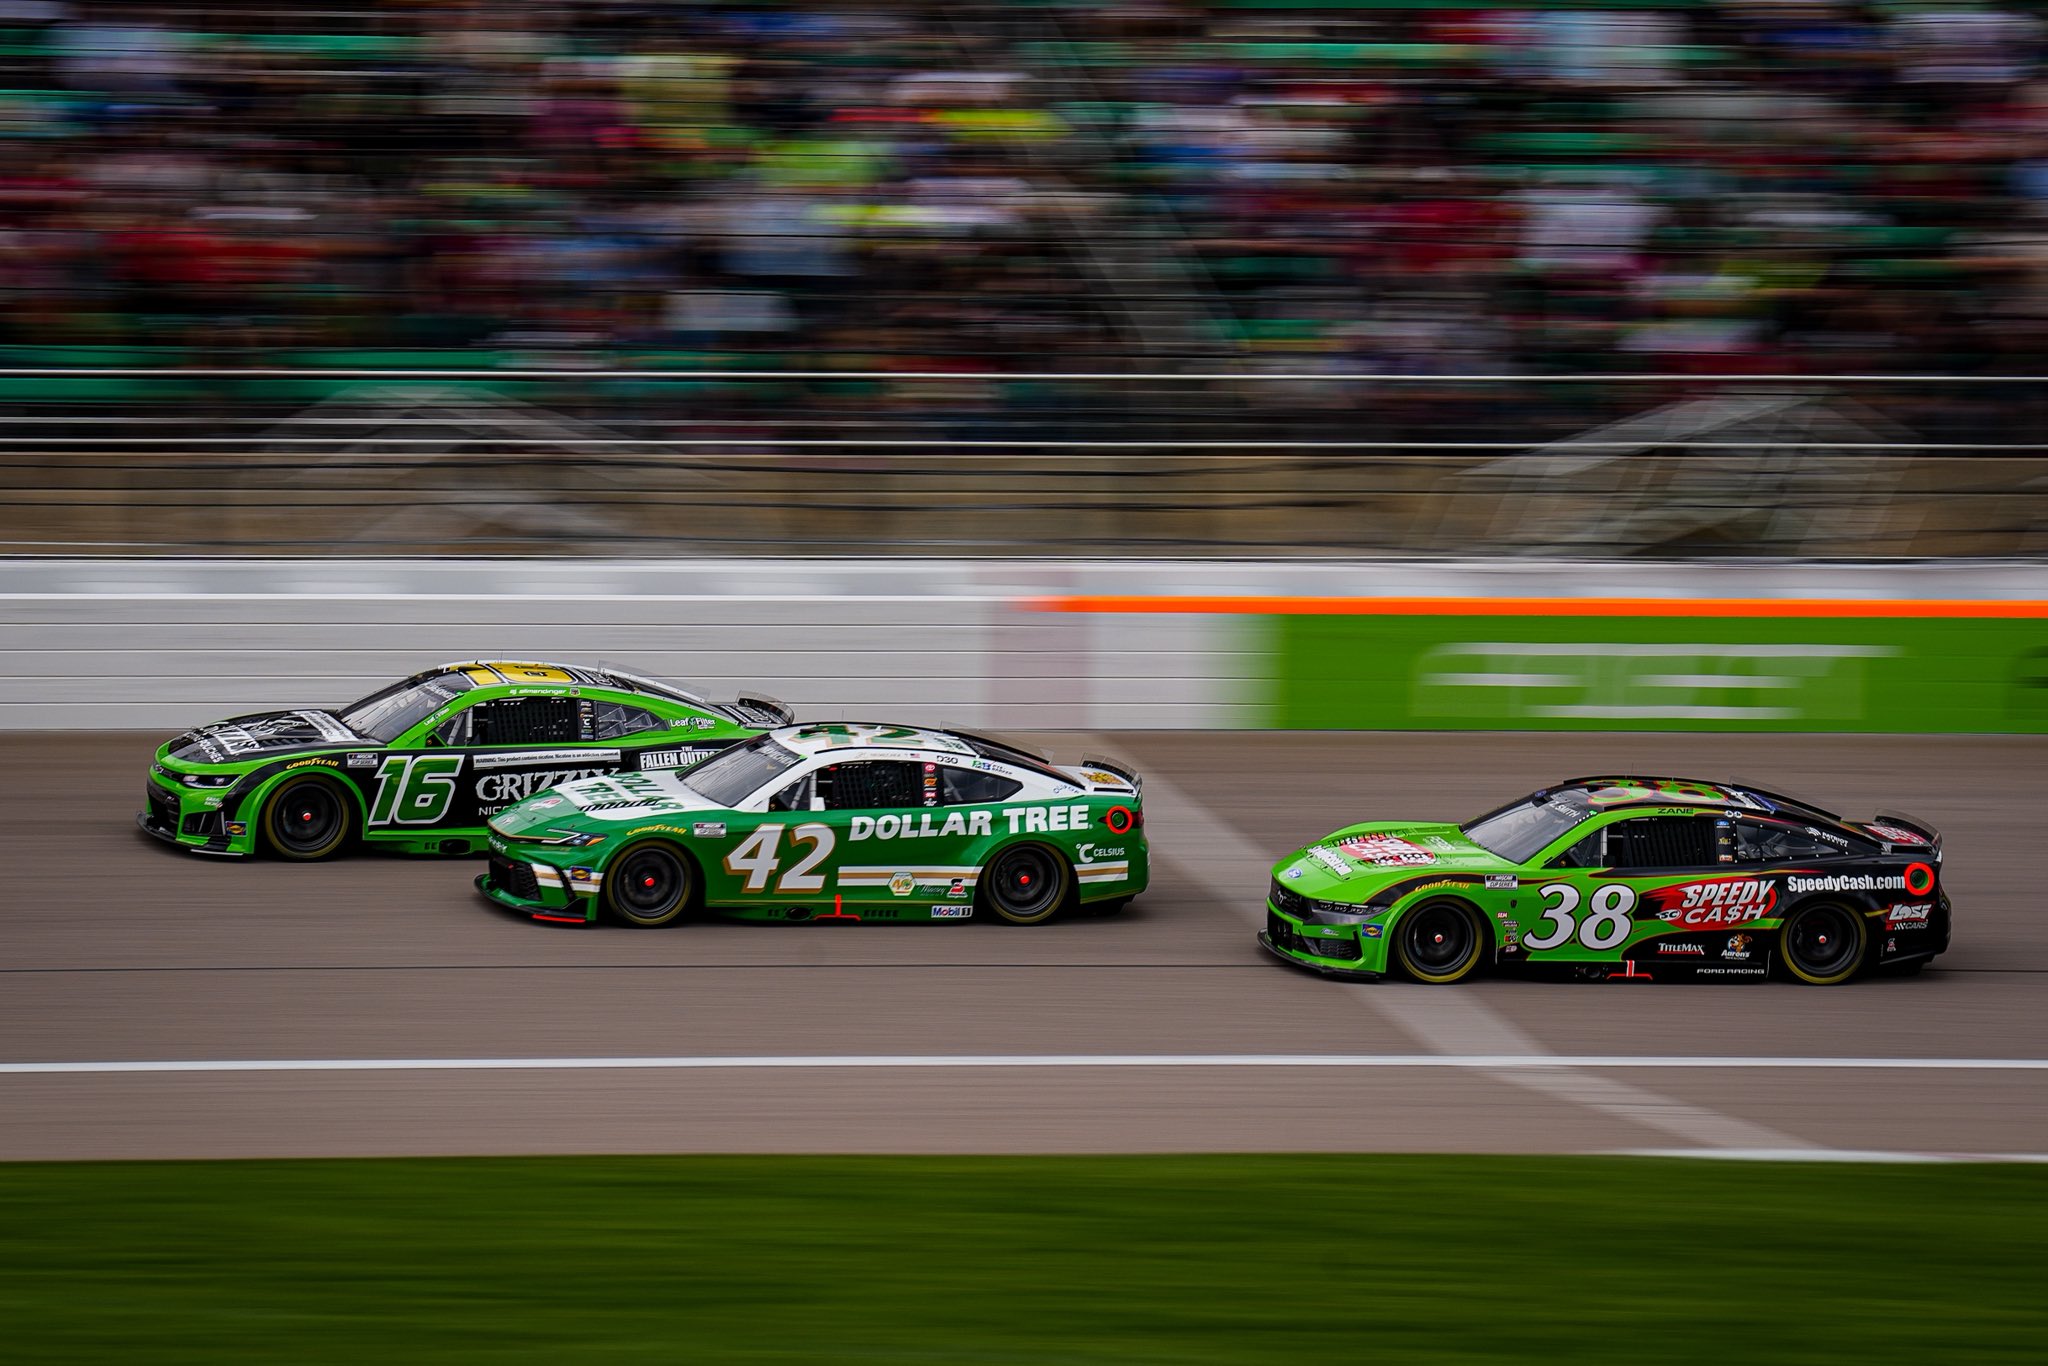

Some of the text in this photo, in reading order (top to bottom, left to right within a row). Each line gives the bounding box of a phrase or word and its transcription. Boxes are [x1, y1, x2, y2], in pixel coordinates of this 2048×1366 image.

[286, 757, 340, 770] GOODYEAR
[640, 753, 678, 769] FALLEN
[367, 754, 465, 826] 16
[475, 767, 620, 801] GRIZ
[626, 824, 686, 836] GOODYEAR
[849, 810, 992, 841] DOLLAR
[723, 823, 836, 894] 42
[1093, 847, 1125, 857] CELSIUS
[1414, 879, 1470, 893] GOODYEAR
[1787, 874, 1906, 893] SpeedyCash.com
[1679, 880, 1776, 908] SPEEDY
[932, 906, 960, 917] Mobil
[1522, 883, 1637, 951] 38
